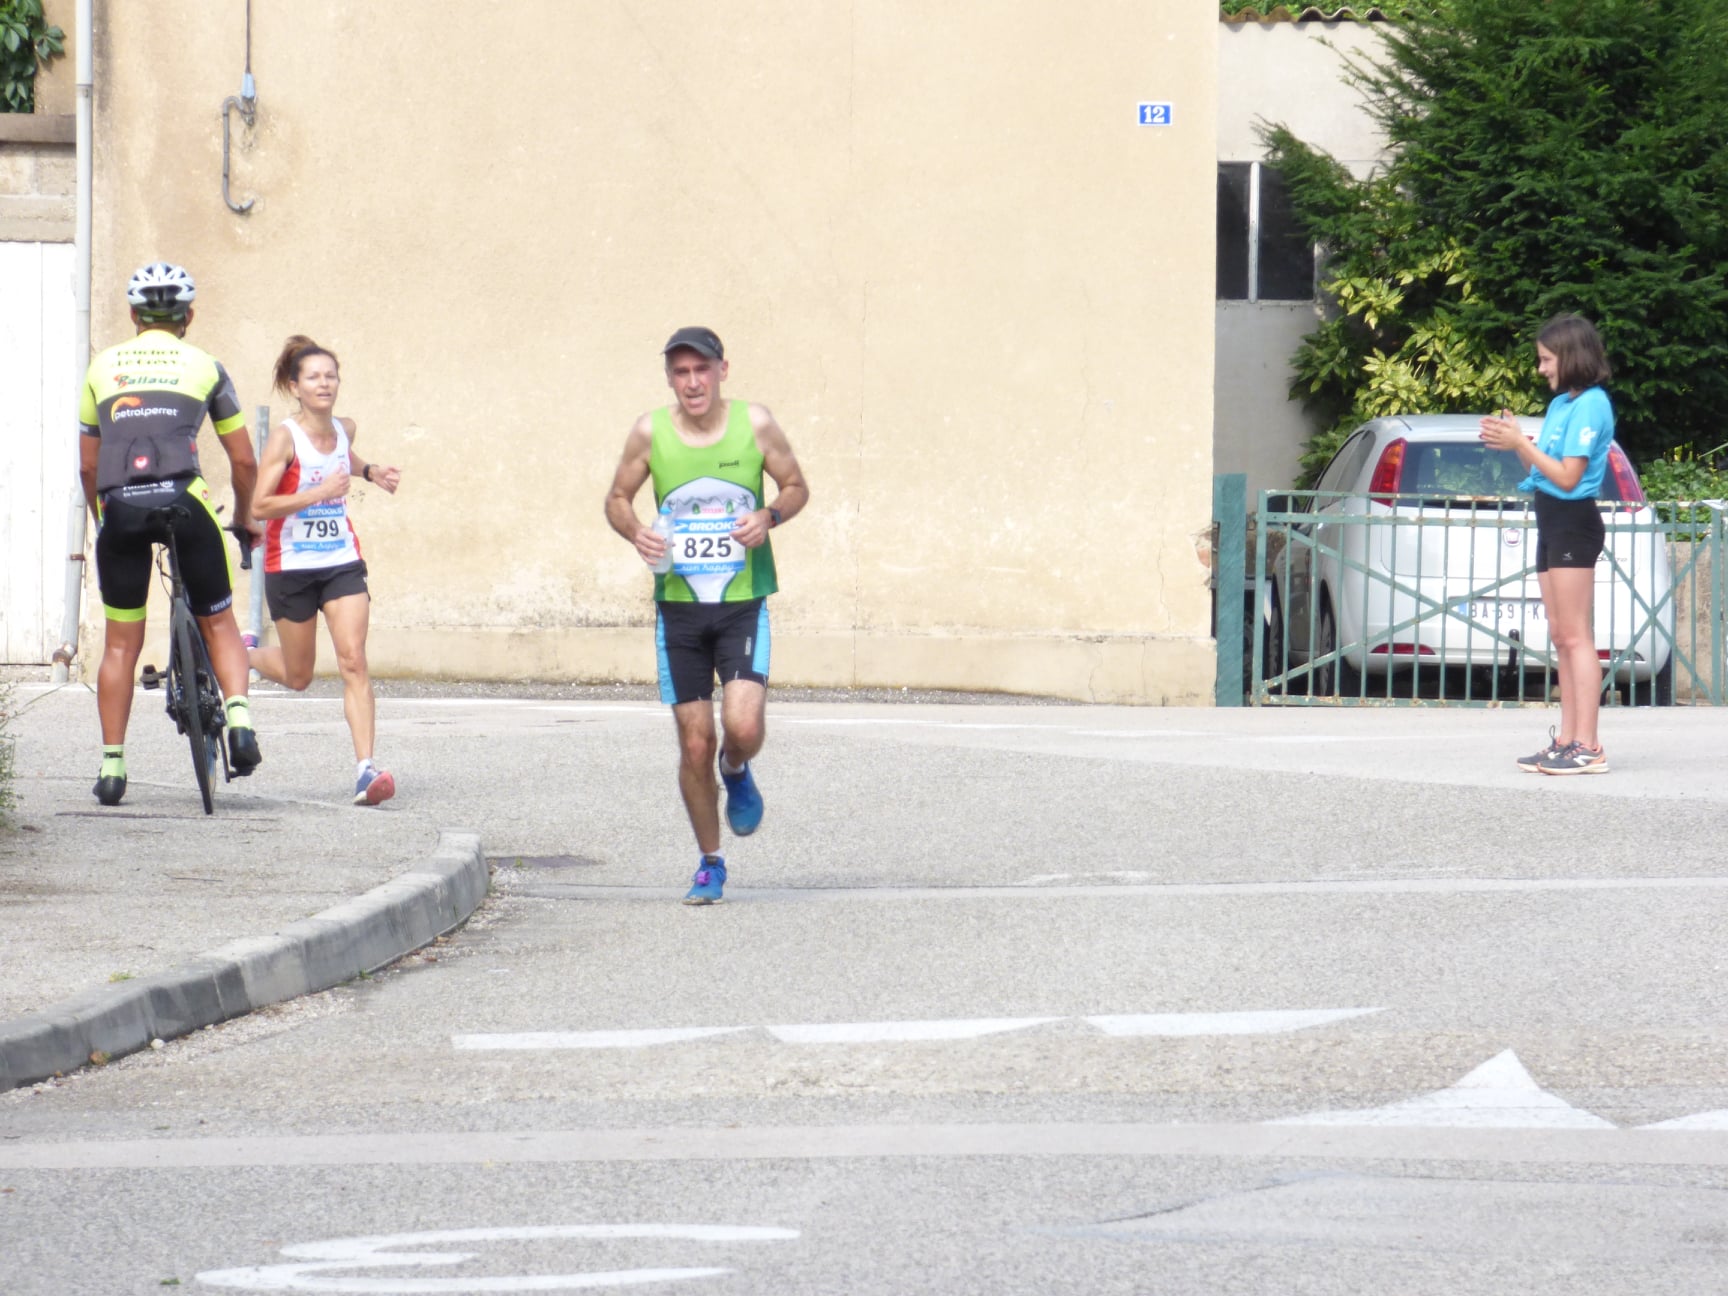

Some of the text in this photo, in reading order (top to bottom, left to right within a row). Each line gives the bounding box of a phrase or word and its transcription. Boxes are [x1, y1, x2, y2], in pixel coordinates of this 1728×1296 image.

[1143, 105, 1166, 123] 12
[114, 407, 178, 420] petrolperret
[303, 520, 339, 538] 799
[684, 537, 732, 558] 825
